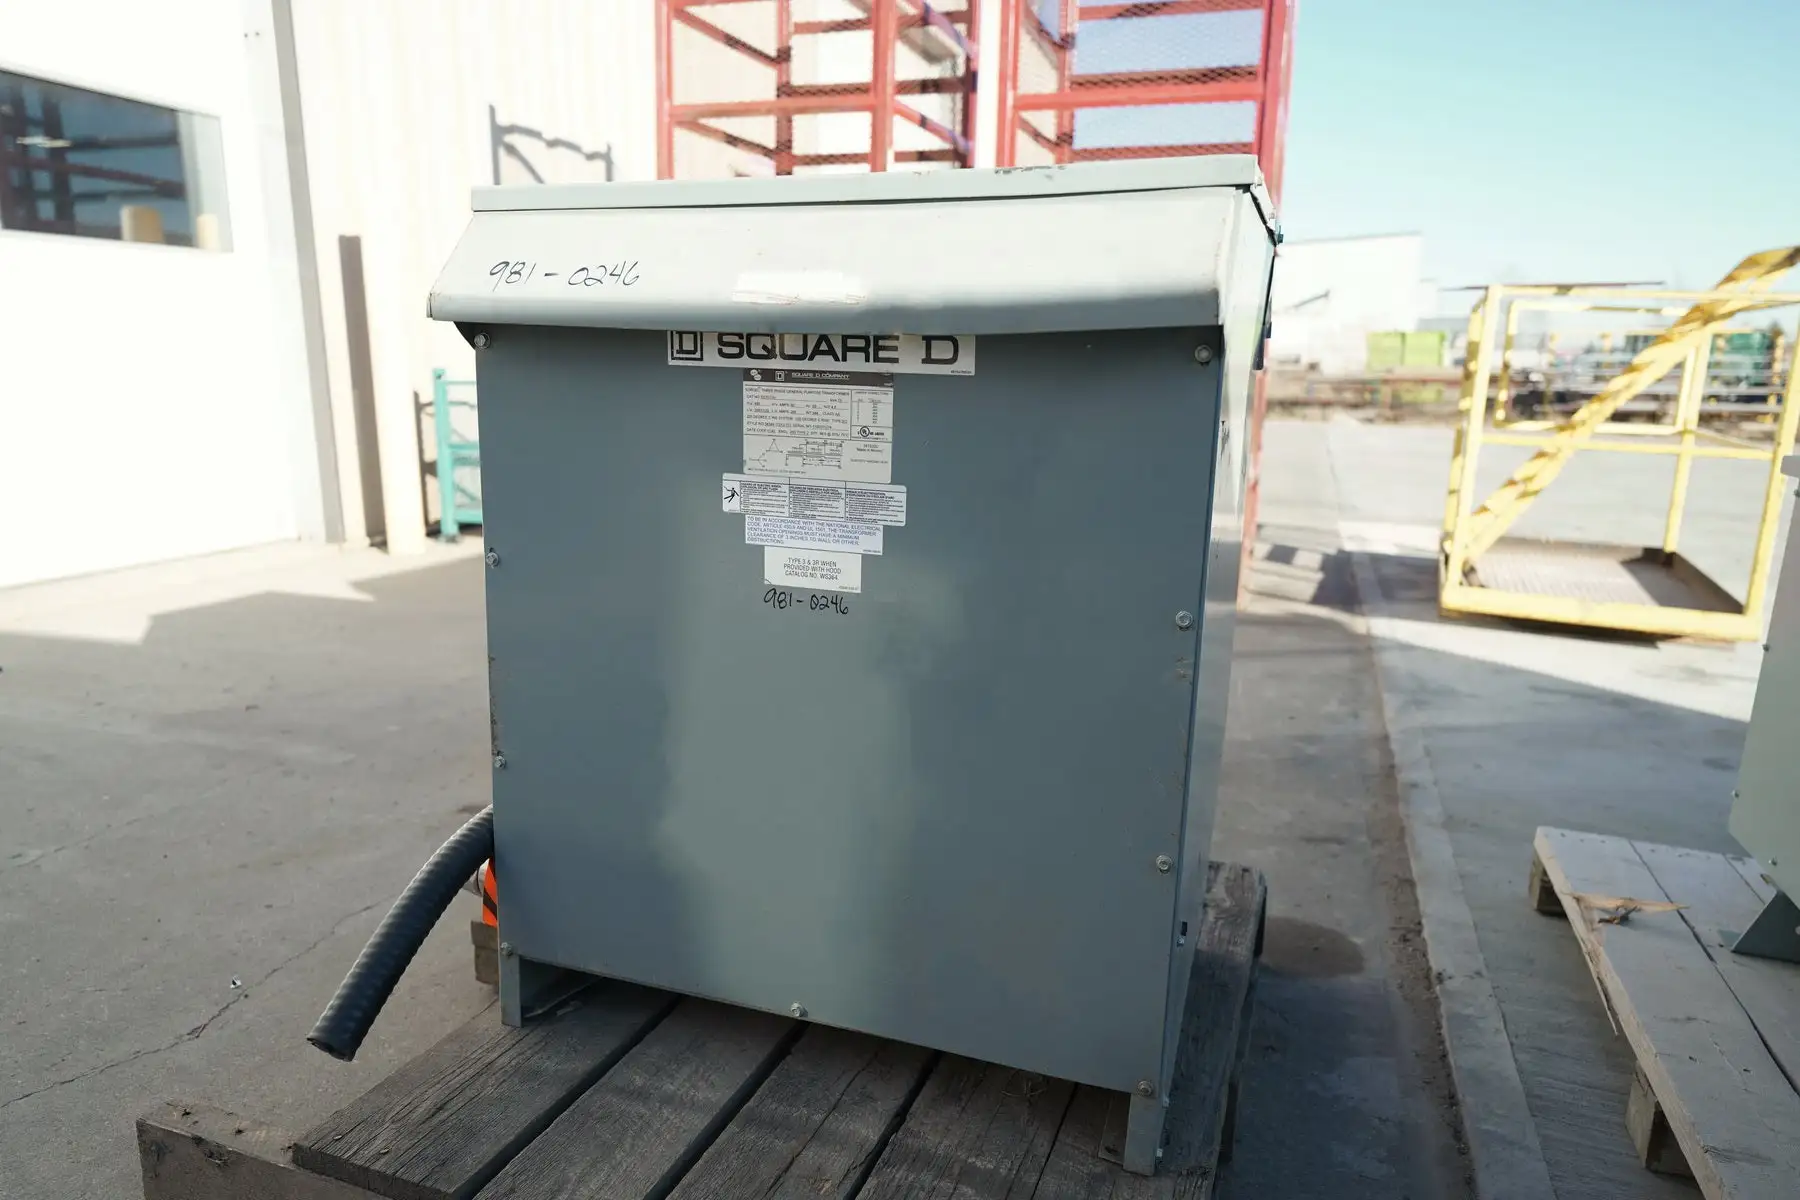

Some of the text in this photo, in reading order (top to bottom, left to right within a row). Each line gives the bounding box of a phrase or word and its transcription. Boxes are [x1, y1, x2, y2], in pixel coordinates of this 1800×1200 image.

[717, 332, 900, 363] SQUARE
[921, 335, 960, 366] D
[822, 373, 850, 381] COMPANY
[826, 521, 850, 529] NATIONAL
[851, 524, 881, 532] ELECTRICAL
[839, 529, 877, 537] TRANSFORMER
[788, 557, 801, 565] TYPE
[812, 559, 820, 567] 3R
[820, 560, 837, 568] WHEN
[784, 563, 810, 572] PROVIDED
[826, 567, 841, 575] HOOD
[785, 569, 808, 578] CATALOG
[763, 587, 849, 615] 981-0246
